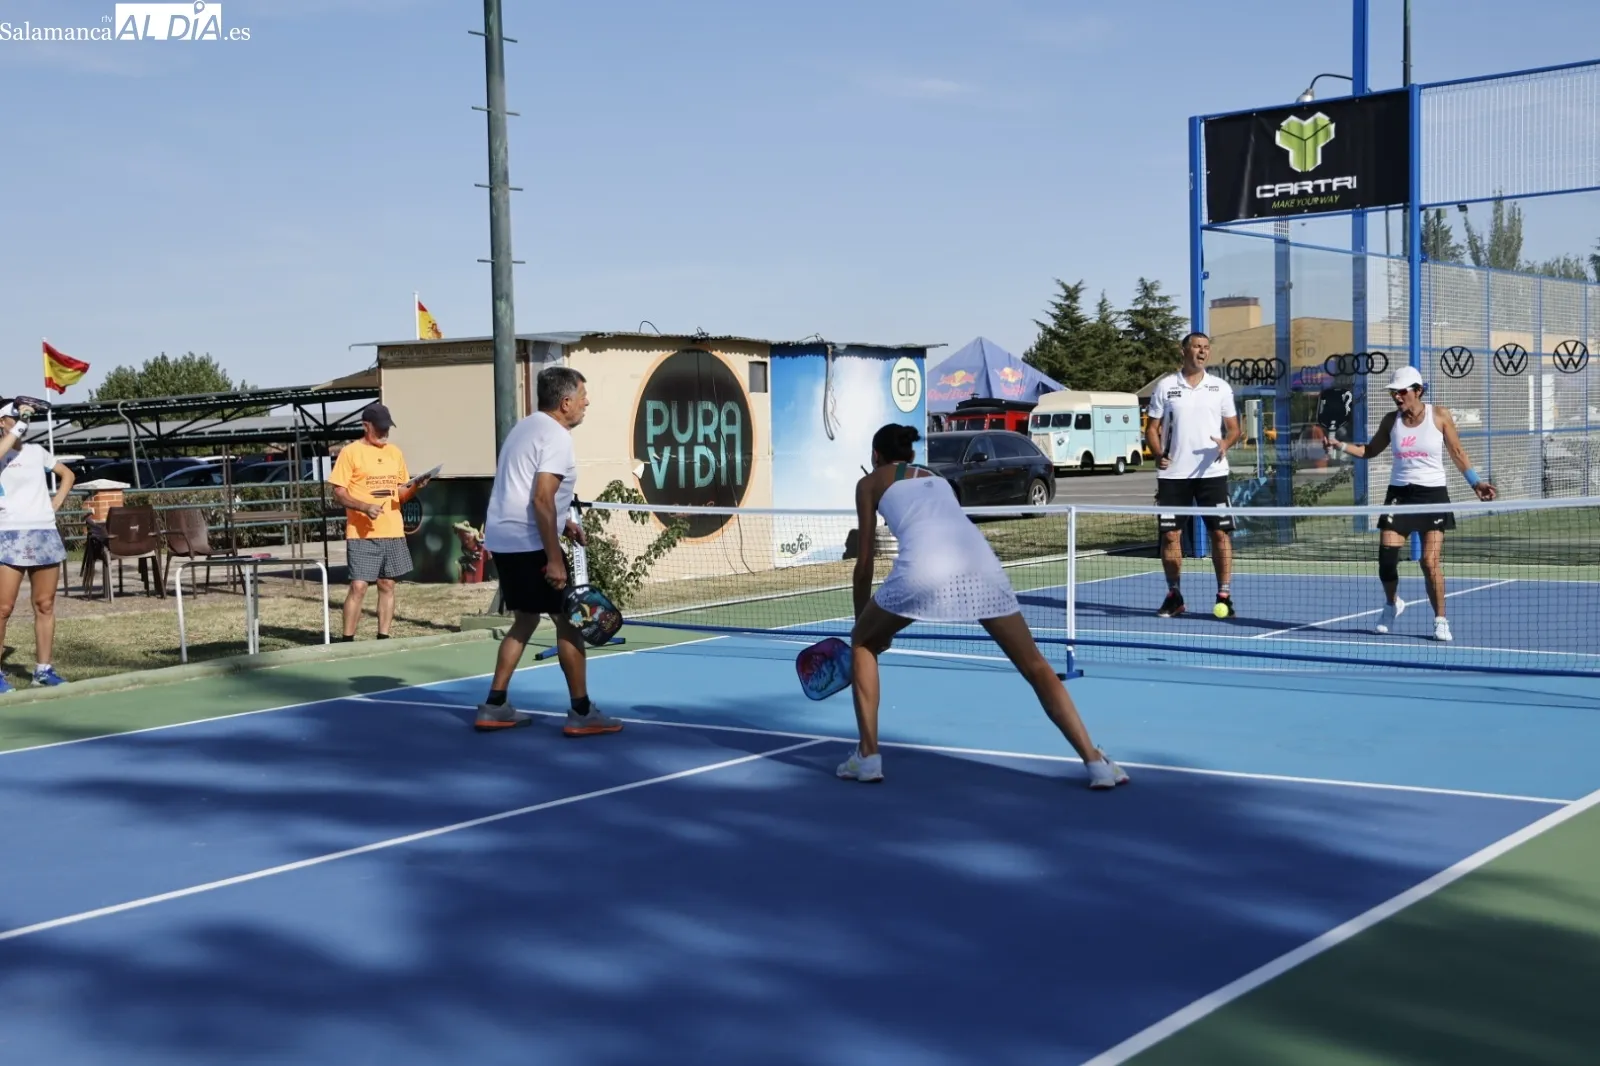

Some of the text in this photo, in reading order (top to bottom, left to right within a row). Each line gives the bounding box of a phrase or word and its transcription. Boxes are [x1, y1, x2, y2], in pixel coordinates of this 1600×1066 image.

[1256, 175, 1357, 199] CARTRI
[1271, 194, 1340, 209] MAKE YOUR WAY
[645, 400, 742, 449] PURA
